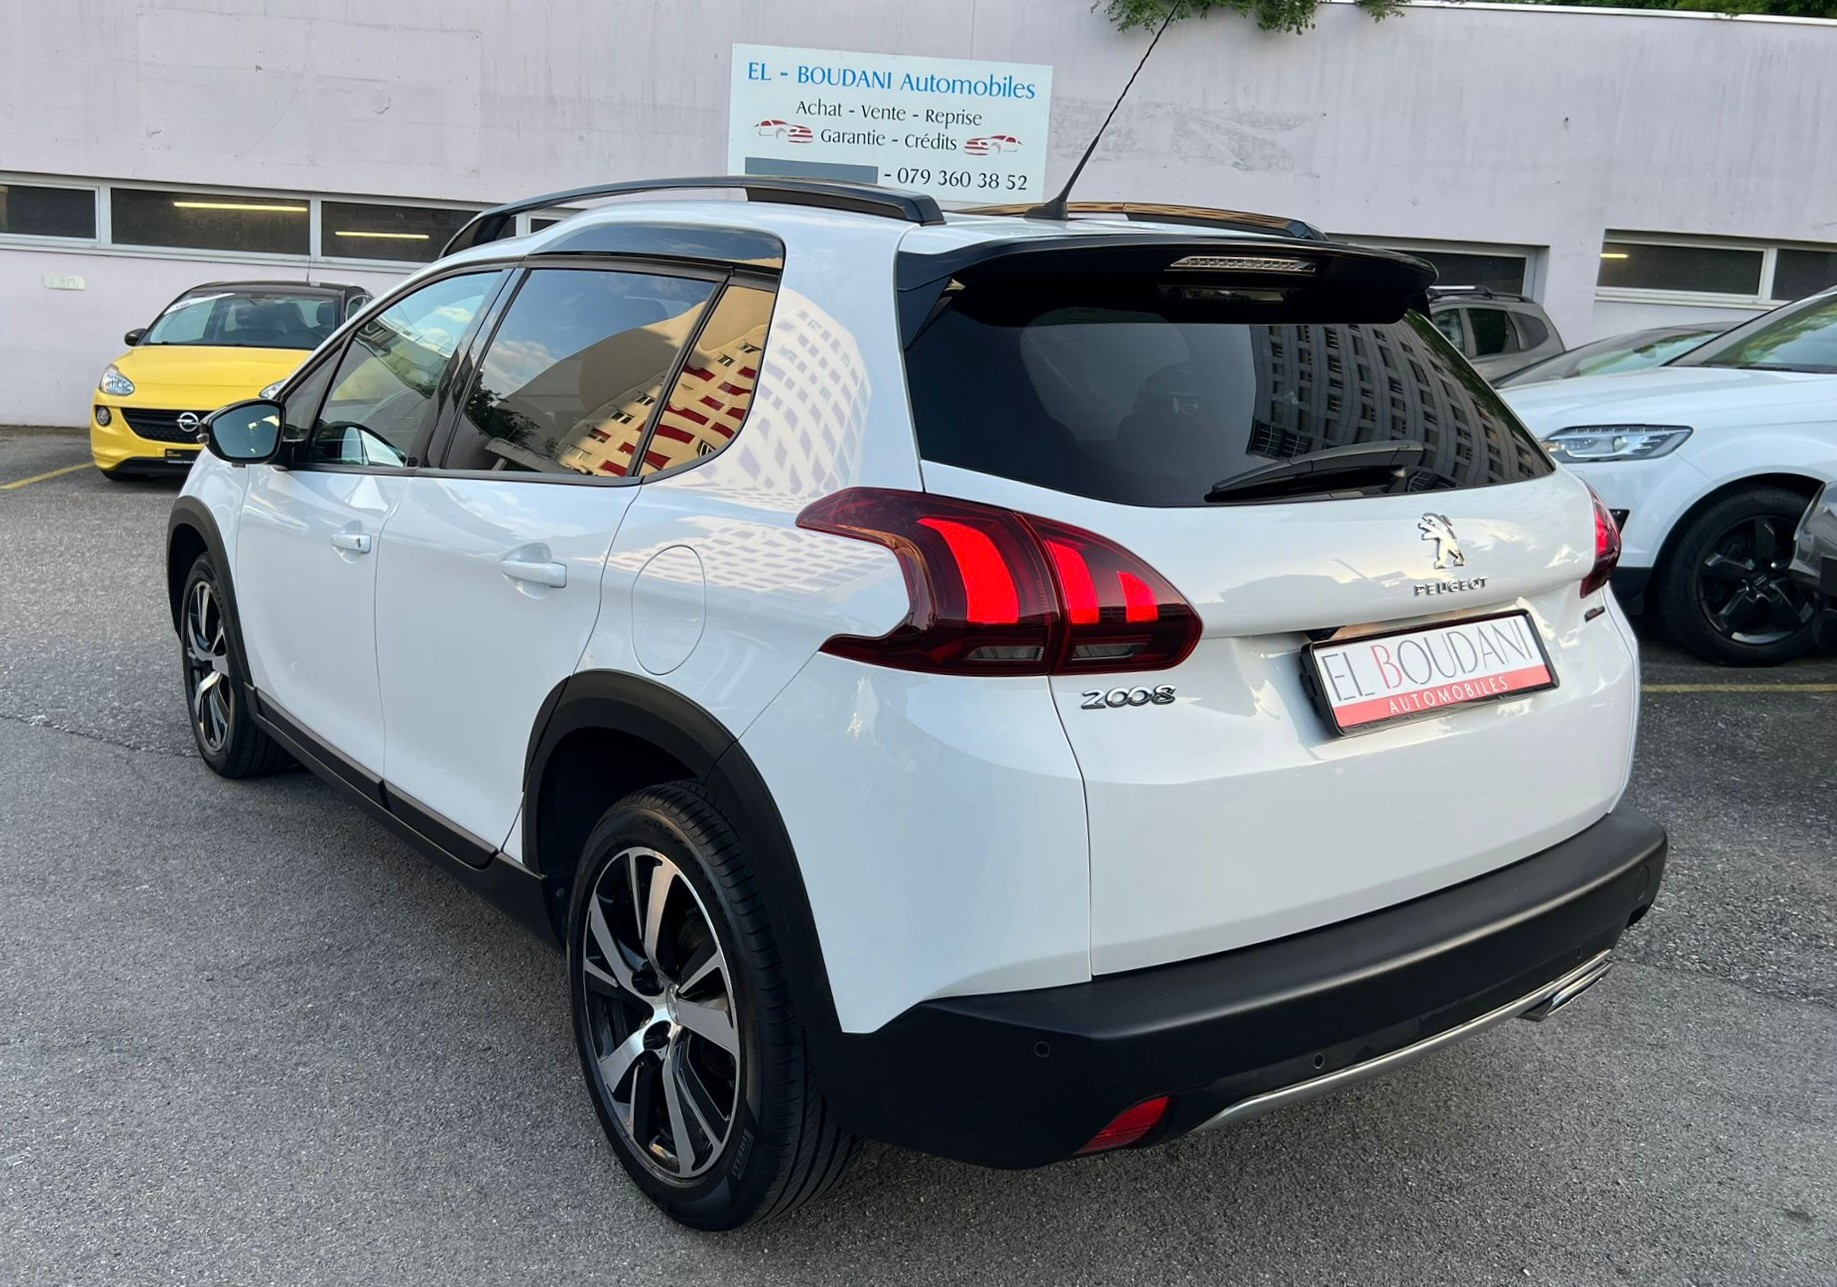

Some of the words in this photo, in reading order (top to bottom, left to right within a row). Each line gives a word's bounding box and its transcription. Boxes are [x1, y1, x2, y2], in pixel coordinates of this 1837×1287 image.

[748, 61, 772, 81] EL
[797, 65, 893, 89] BOUDANI
[900, 73, 1036, 99] Automobiles
[796, 98, 843, 117] Achat
[861, 104, 906, 121] Vente
[925, 109, 982, 129] Reprise
[820, 128, 886, 146] Garantie
[904, 132, 957, 151] Crédits
[897, 167, 931, 185] 079
[937, 170, 972, 188] 360
[977, 172, 1000, 189] 38
[1006, 174, 1028, 190] 52
[1413, 577, 1488, 597] PEUGEOT
[1321, 652, 1375, 701] EL
[1370, 619, 1533, 689] BOUDANI
[1081, 684, 1176, 709] 2008
[1389, 675, 1508, 715] AUTOMOBILES
